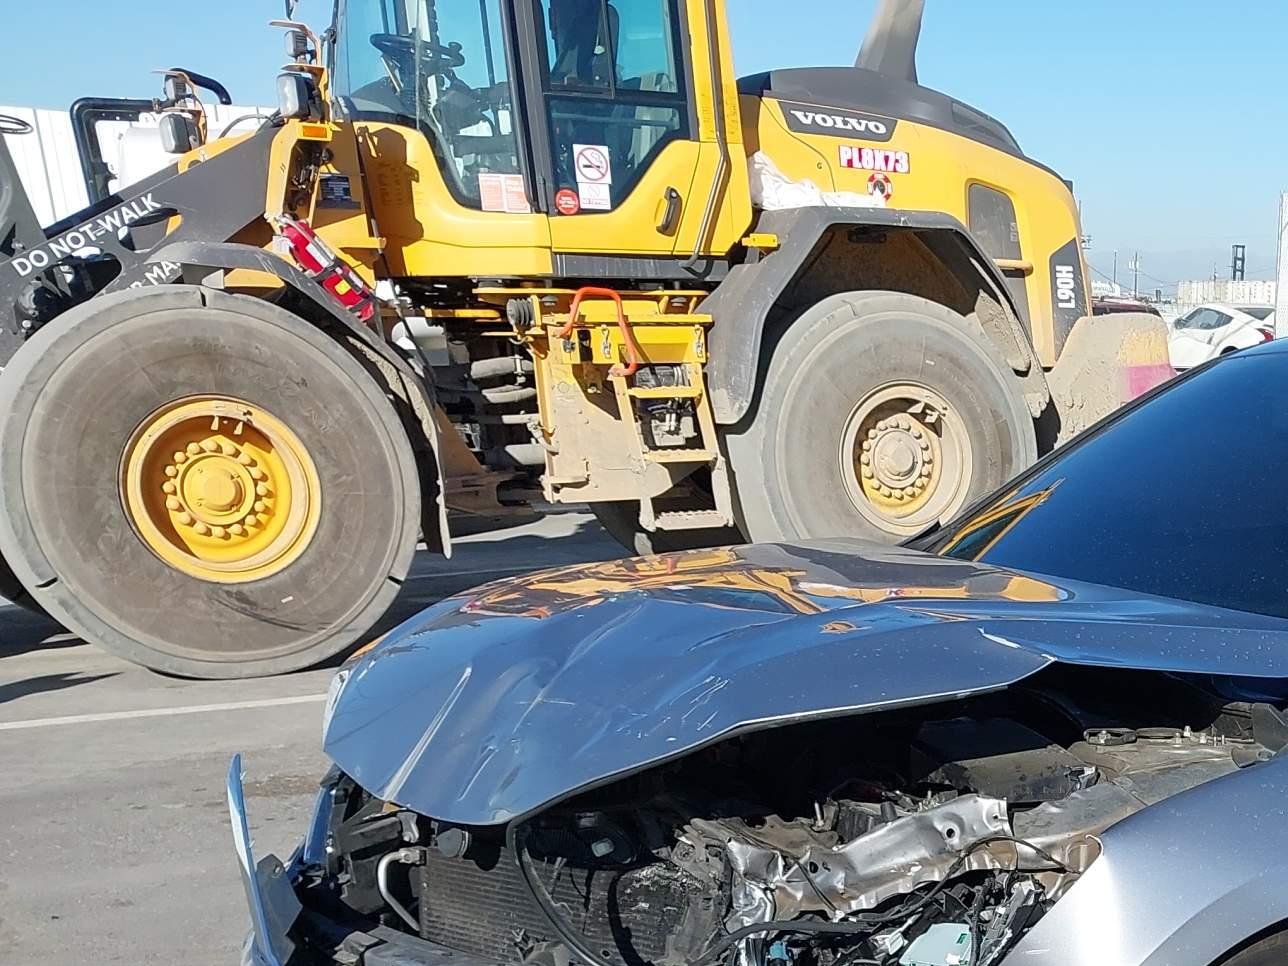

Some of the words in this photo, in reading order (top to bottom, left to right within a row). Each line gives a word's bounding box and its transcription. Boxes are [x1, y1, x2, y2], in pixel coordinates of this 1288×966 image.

[790, 109, 887, 134] VOLVO
[12, 249, 48, 277] DO
[48, 223, 98, 258] NOT
[97, 192, 161, 233] WALK
[1055, 265, 1076, 309] L90H
